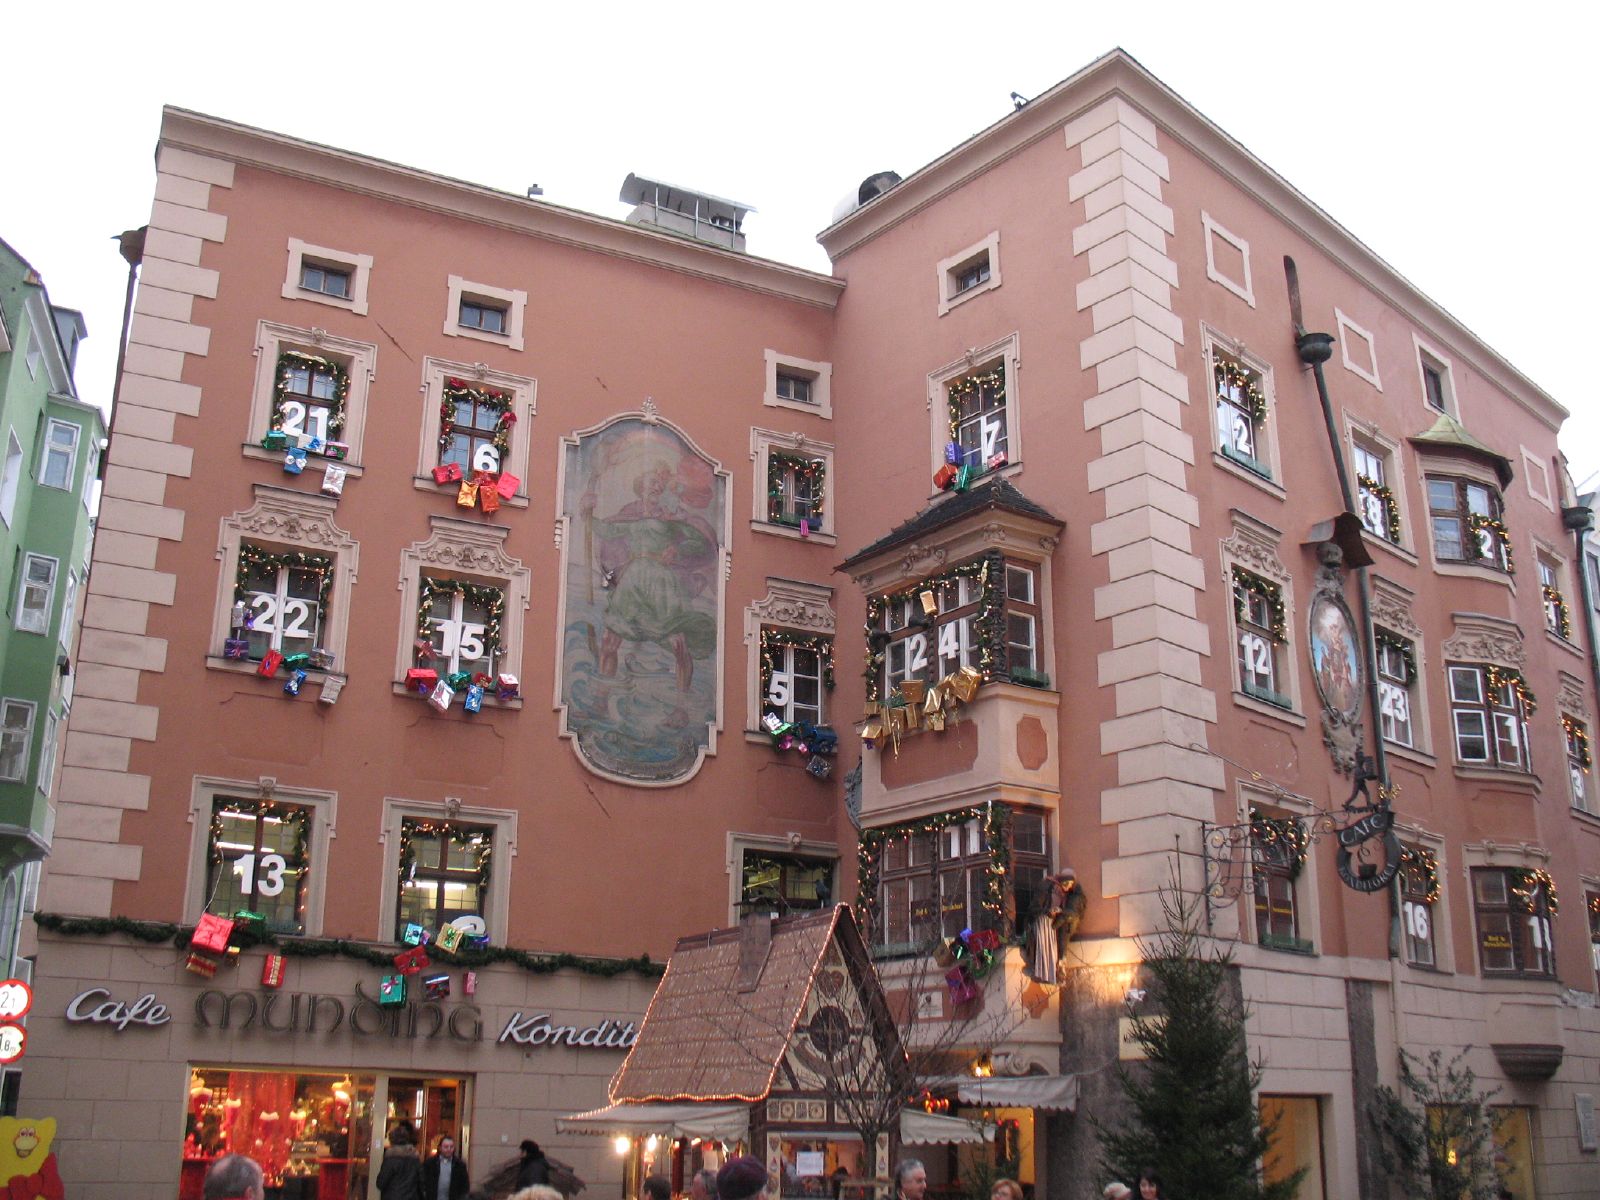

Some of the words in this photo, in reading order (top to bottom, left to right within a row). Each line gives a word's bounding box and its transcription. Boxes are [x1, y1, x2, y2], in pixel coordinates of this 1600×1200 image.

[281, 401, 328, 442] 21
[473, 443, 499, 473] 6
[251, 595, 309, 638] 22
[436, 620, 485, 660] 15
[910, 621, 959, 672] 24
[1241, 635, 1270, 675] 12
[769, 670, 789, 706] 5
[1379, 683, 1405, 721] 23
[944, 819, 980, 858] 11
[233, 854, 286, 897] 13
[1404, 901, 1428, 939] 16
[67, 988, 171, 1031] Cafe
[500, 1012, 639, 1047] Kondit
